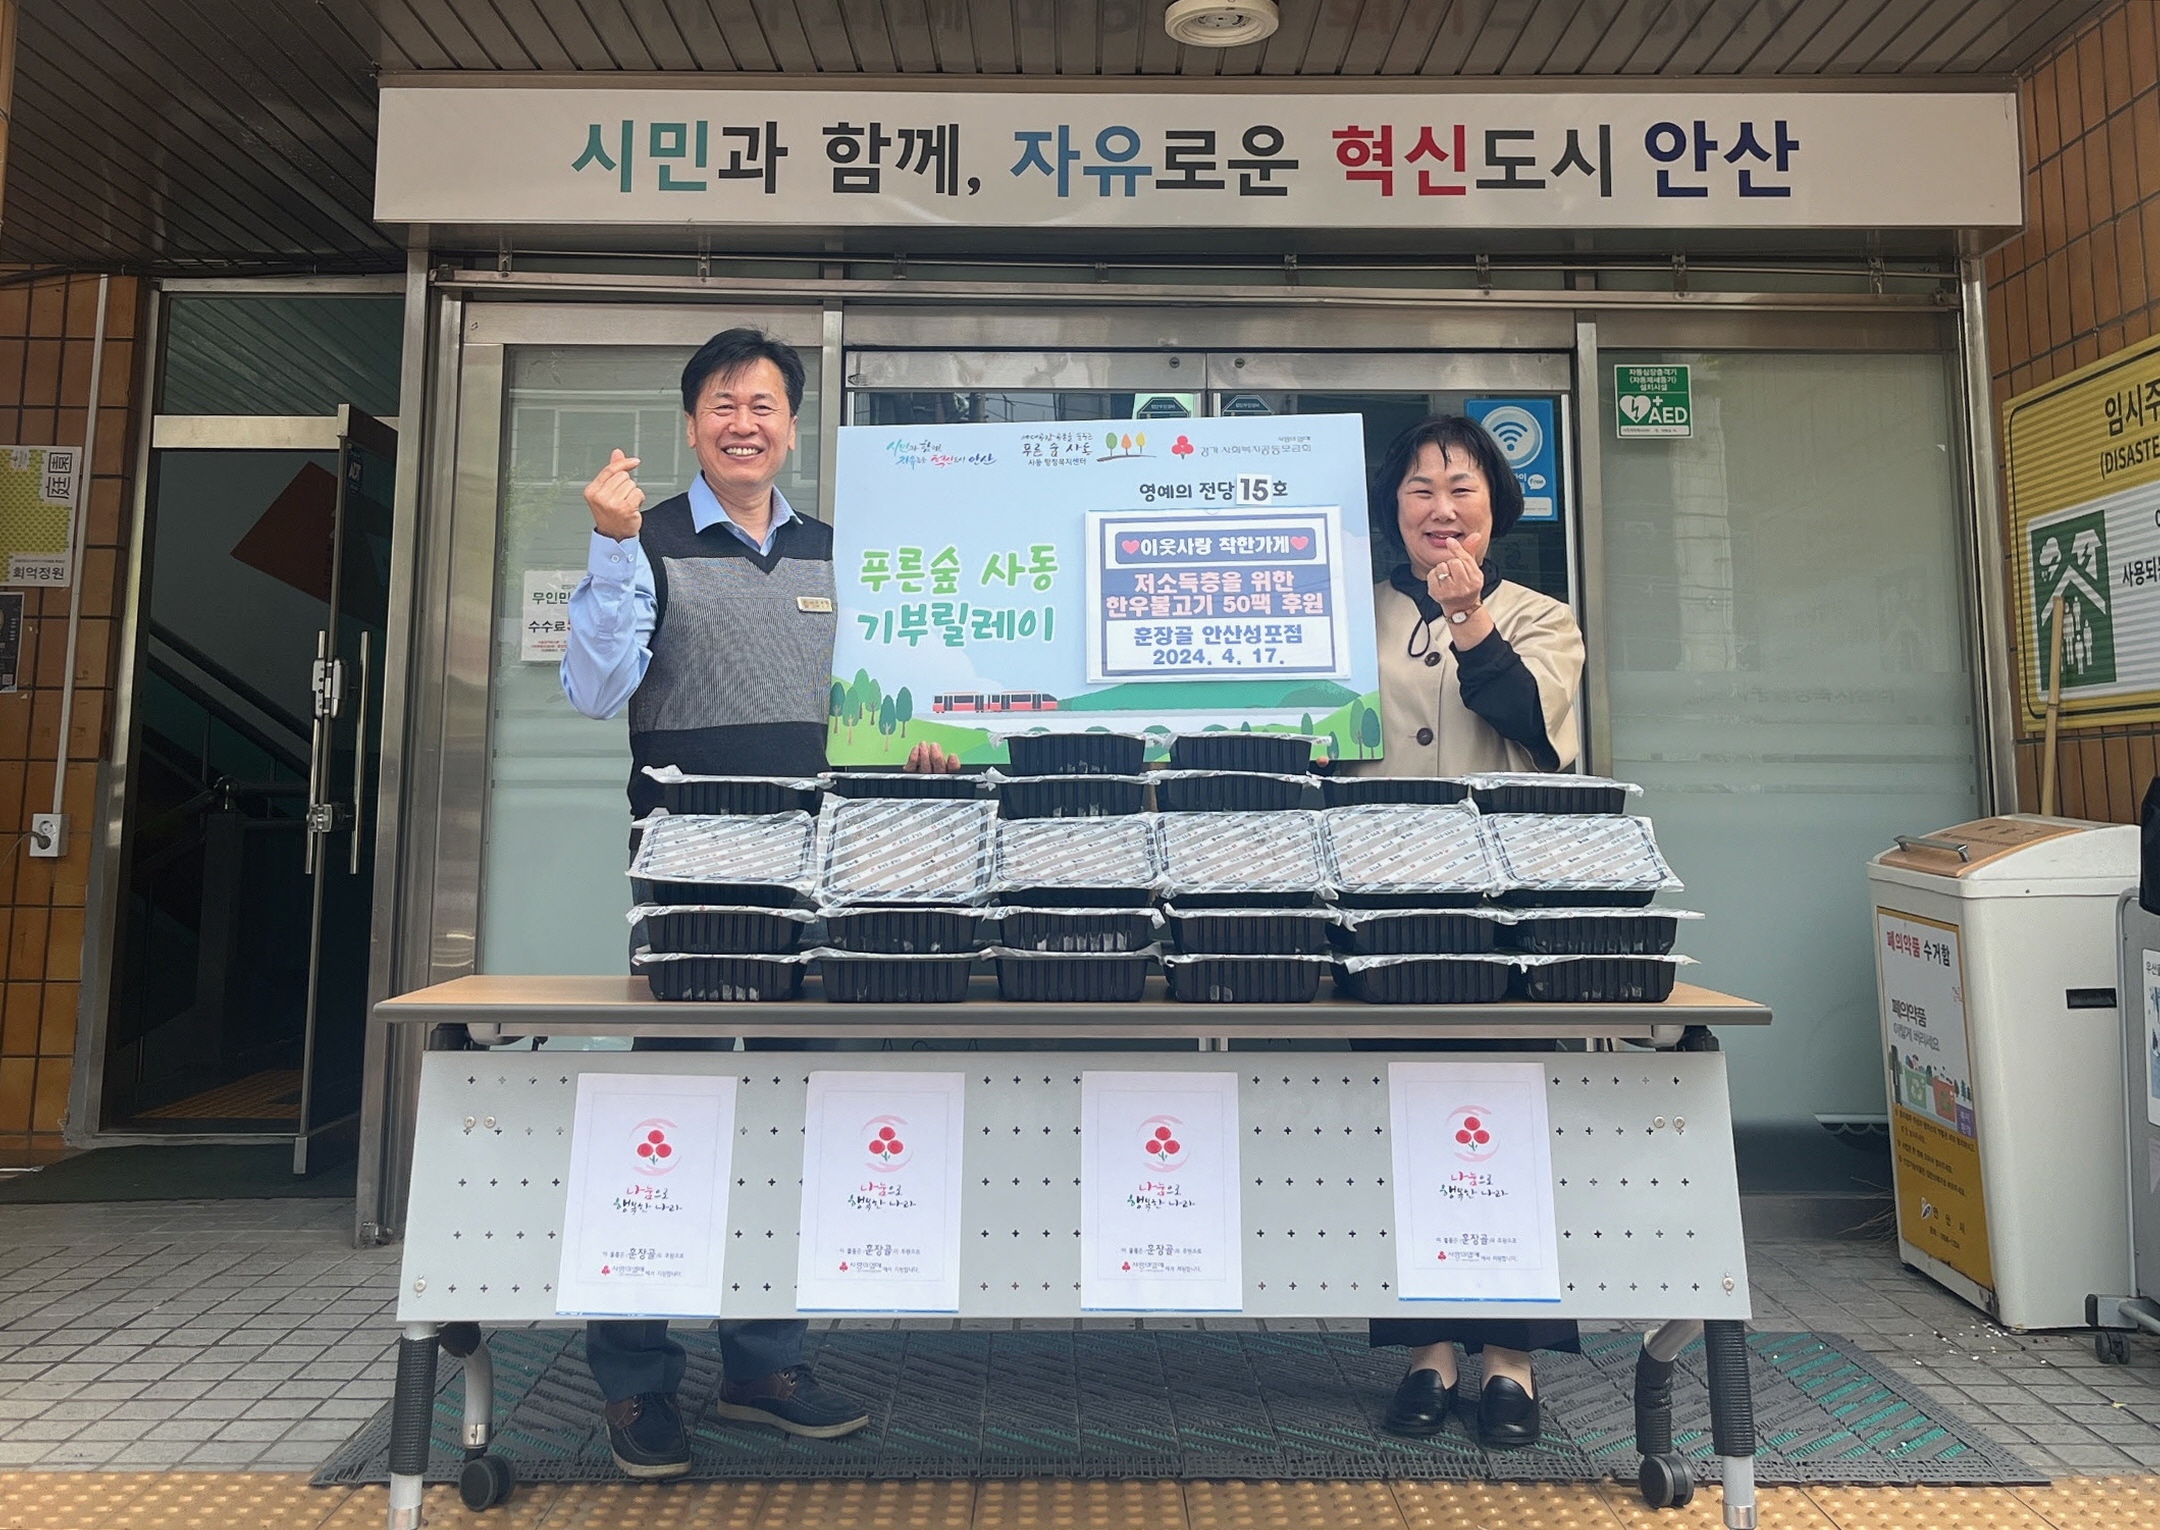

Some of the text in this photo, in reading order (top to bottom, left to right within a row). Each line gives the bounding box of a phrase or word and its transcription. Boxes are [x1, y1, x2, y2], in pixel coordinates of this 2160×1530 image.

[572, 120, 1800, 199] 시민과 함께, 자유로운 혁신도시 안산
[1648, 406, 1688, 424] AED
[968, 453, 997, 465] 안산
[1200, 446, 1219, 458] 경기
[1139, 483, 1193, 502] 영예의
[1199, 481, 1235, 501] 전당
[1140, 534, 1290, 558] 이웃사랑 착한가게
[857, 542, 1059, 594] 푸른숲 사동
[2122, 556, 2160, 588] 사용되
[1134, 570, 1294, 596] 저소득층을 위한
[1106, 591, 1324, 618] 한우불고기 50팩 후원
[856, 602, 1056, 648] 기부릴레이
[1134, 624, 1303, 648] 훈장골 안산성포점
[1153, 646, 1285, 667] 2024. 4. 17.
[1886, 931, 1951, 967] 폐의약품 수거함
[1891, 998, 1927, 1028] 폐의약품
[860, 1181, 903, 1197] 나눔으로
[1139, 1181, 1182, 1196] 나눔으로
[1450, 1171, 1494, 1187] 나눔으로
[626, 1184, 669, 1200] 나눔으로
